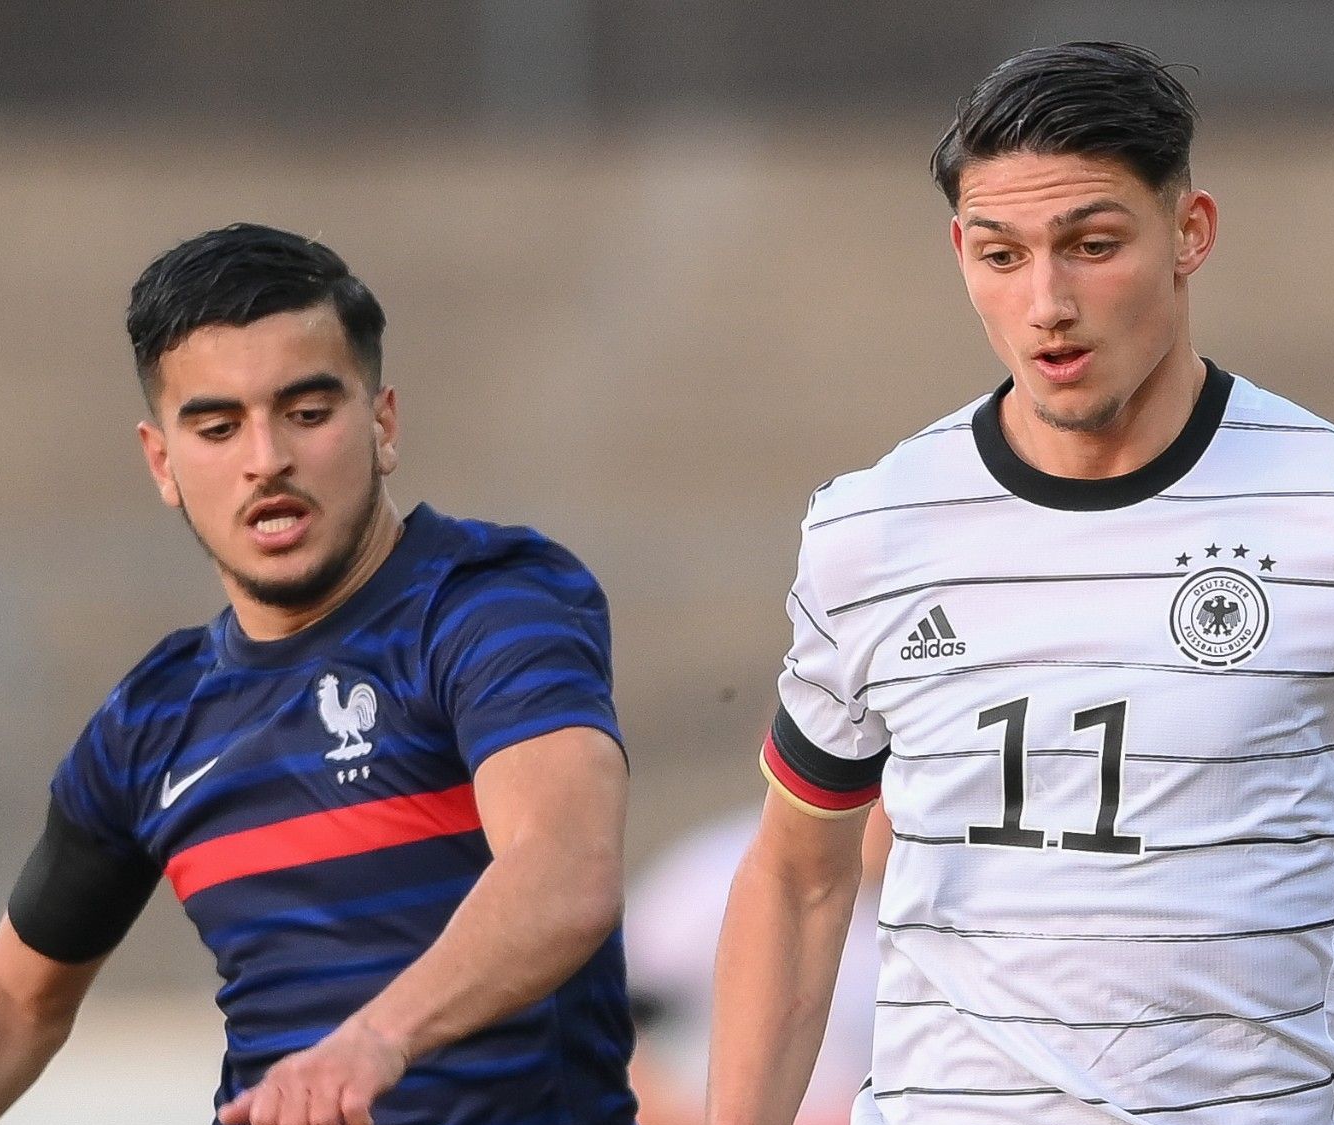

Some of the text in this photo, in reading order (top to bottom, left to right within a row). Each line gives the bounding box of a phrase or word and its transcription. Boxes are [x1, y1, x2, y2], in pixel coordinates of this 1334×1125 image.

[1193, 580, 1249, 599] DEUTSCHER
[900, 639, 966, 660] adidas
[1184, 626, 1252, 653] FUSSBALL-BUND
[967, 696, 1144, 856] 11
